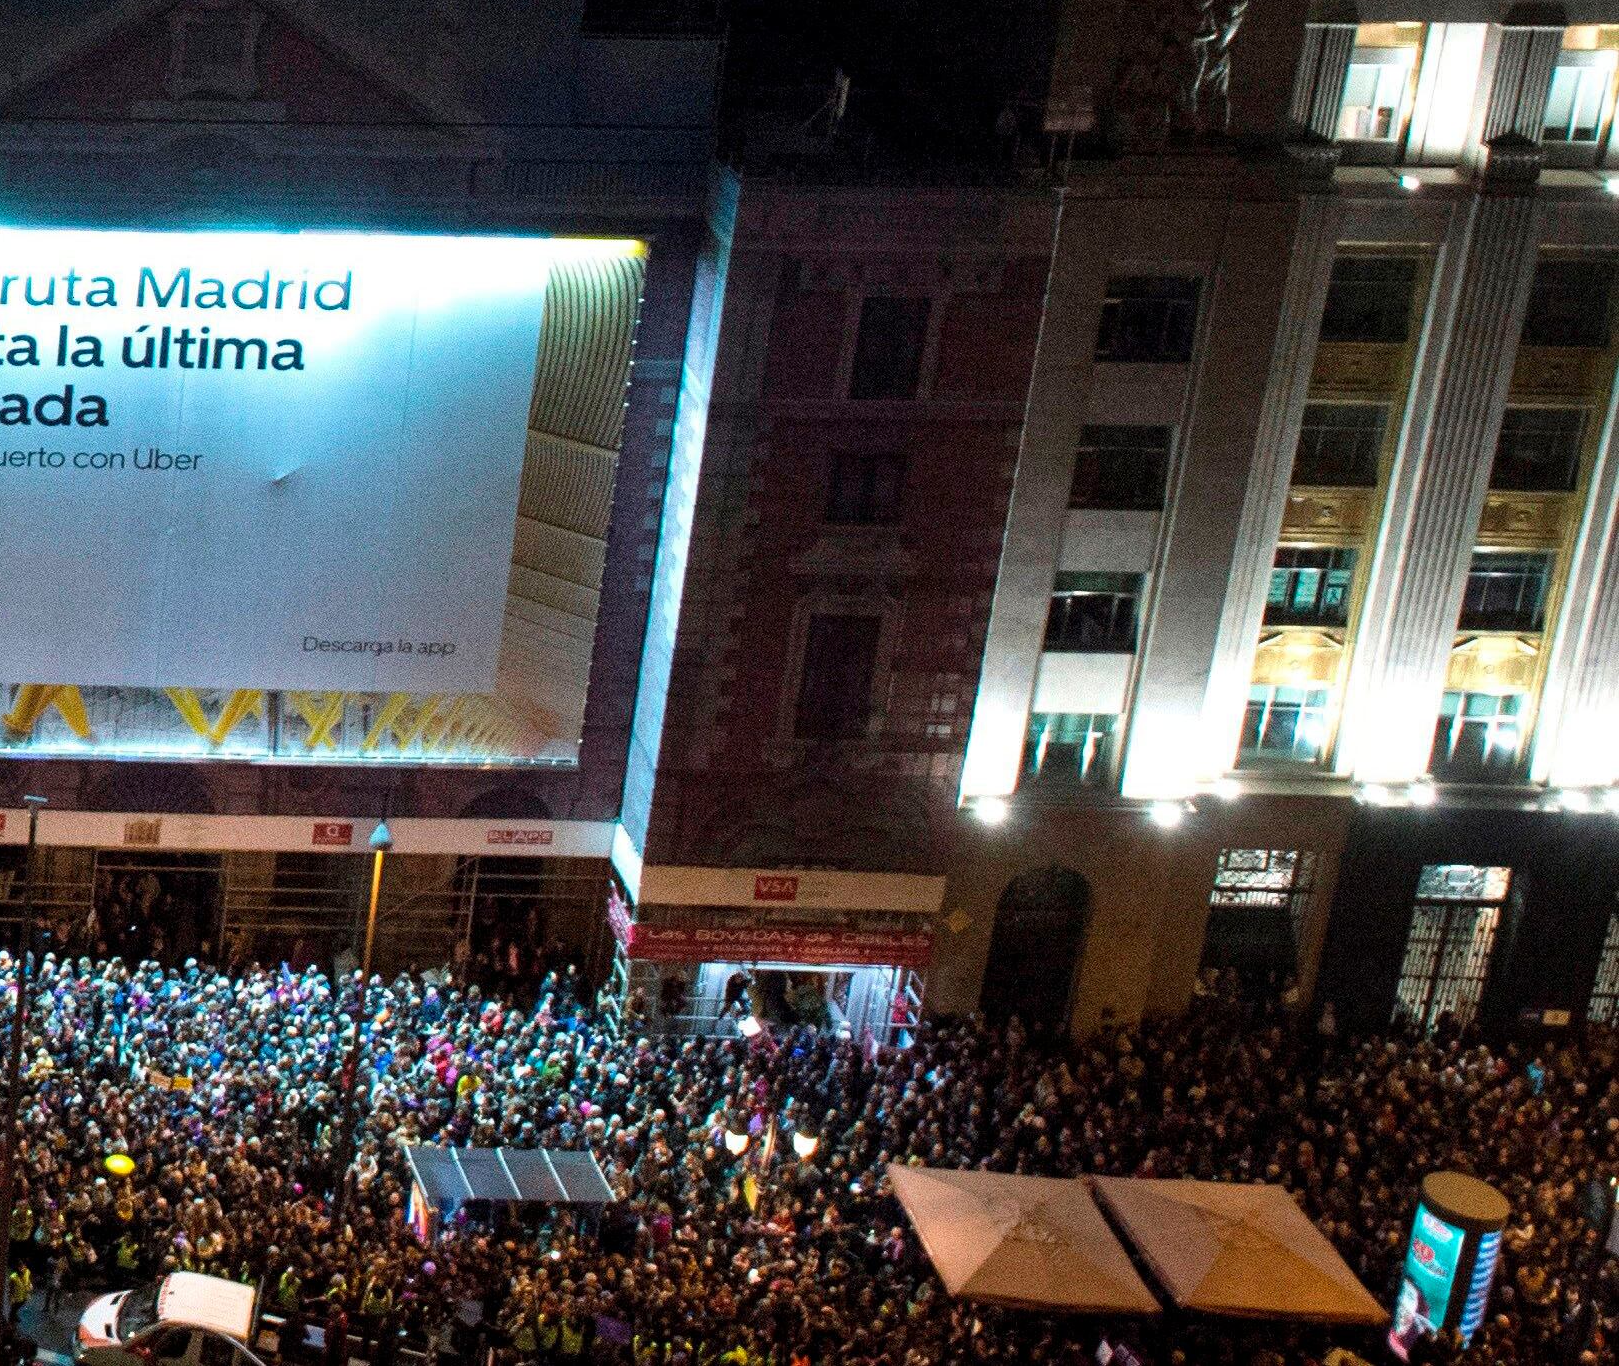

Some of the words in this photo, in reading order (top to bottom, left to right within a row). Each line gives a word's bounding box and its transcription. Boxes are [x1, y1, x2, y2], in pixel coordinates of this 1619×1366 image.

[136, 266, 353, 311] Madrid
[56, 324, 104, 368] la
[122, 324, 304, 371] última
[73, 449, 125, 470] con
[134, 448, 203, 471] Uber
[302, 635, 394, 656] Descarga
[397, 638, 413, 654] la
[416, 640, 457, 657] app
